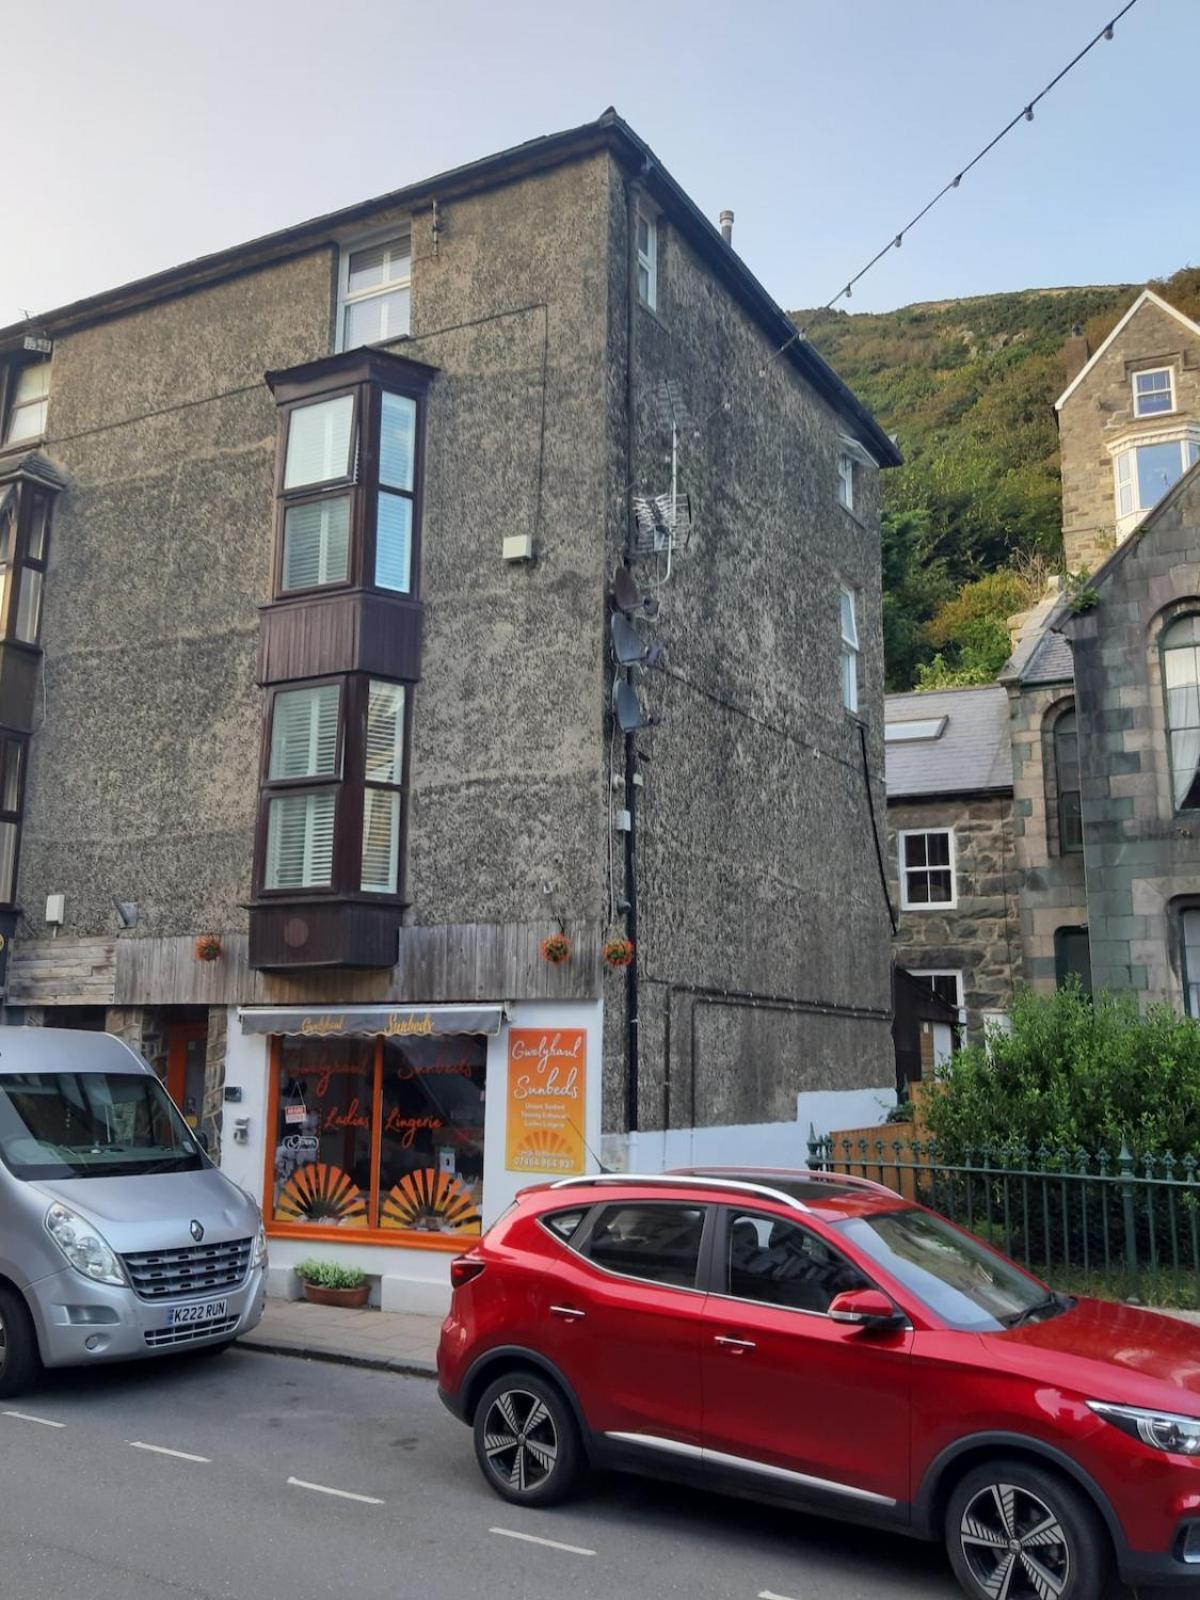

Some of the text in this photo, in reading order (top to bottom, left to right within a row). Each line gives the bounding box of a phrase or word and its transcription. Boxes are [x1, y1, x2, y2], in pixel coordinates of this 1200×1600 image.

[384, 1012, 434, 1033] Sunbeds
[513, 1067, 578, 1099] Sunbeds
[325, 1098, 370, 1129] Ladies
[384, 1106, 443, 1148] Lingerie
[174, 1302, 224, 1322] K222 RUN
